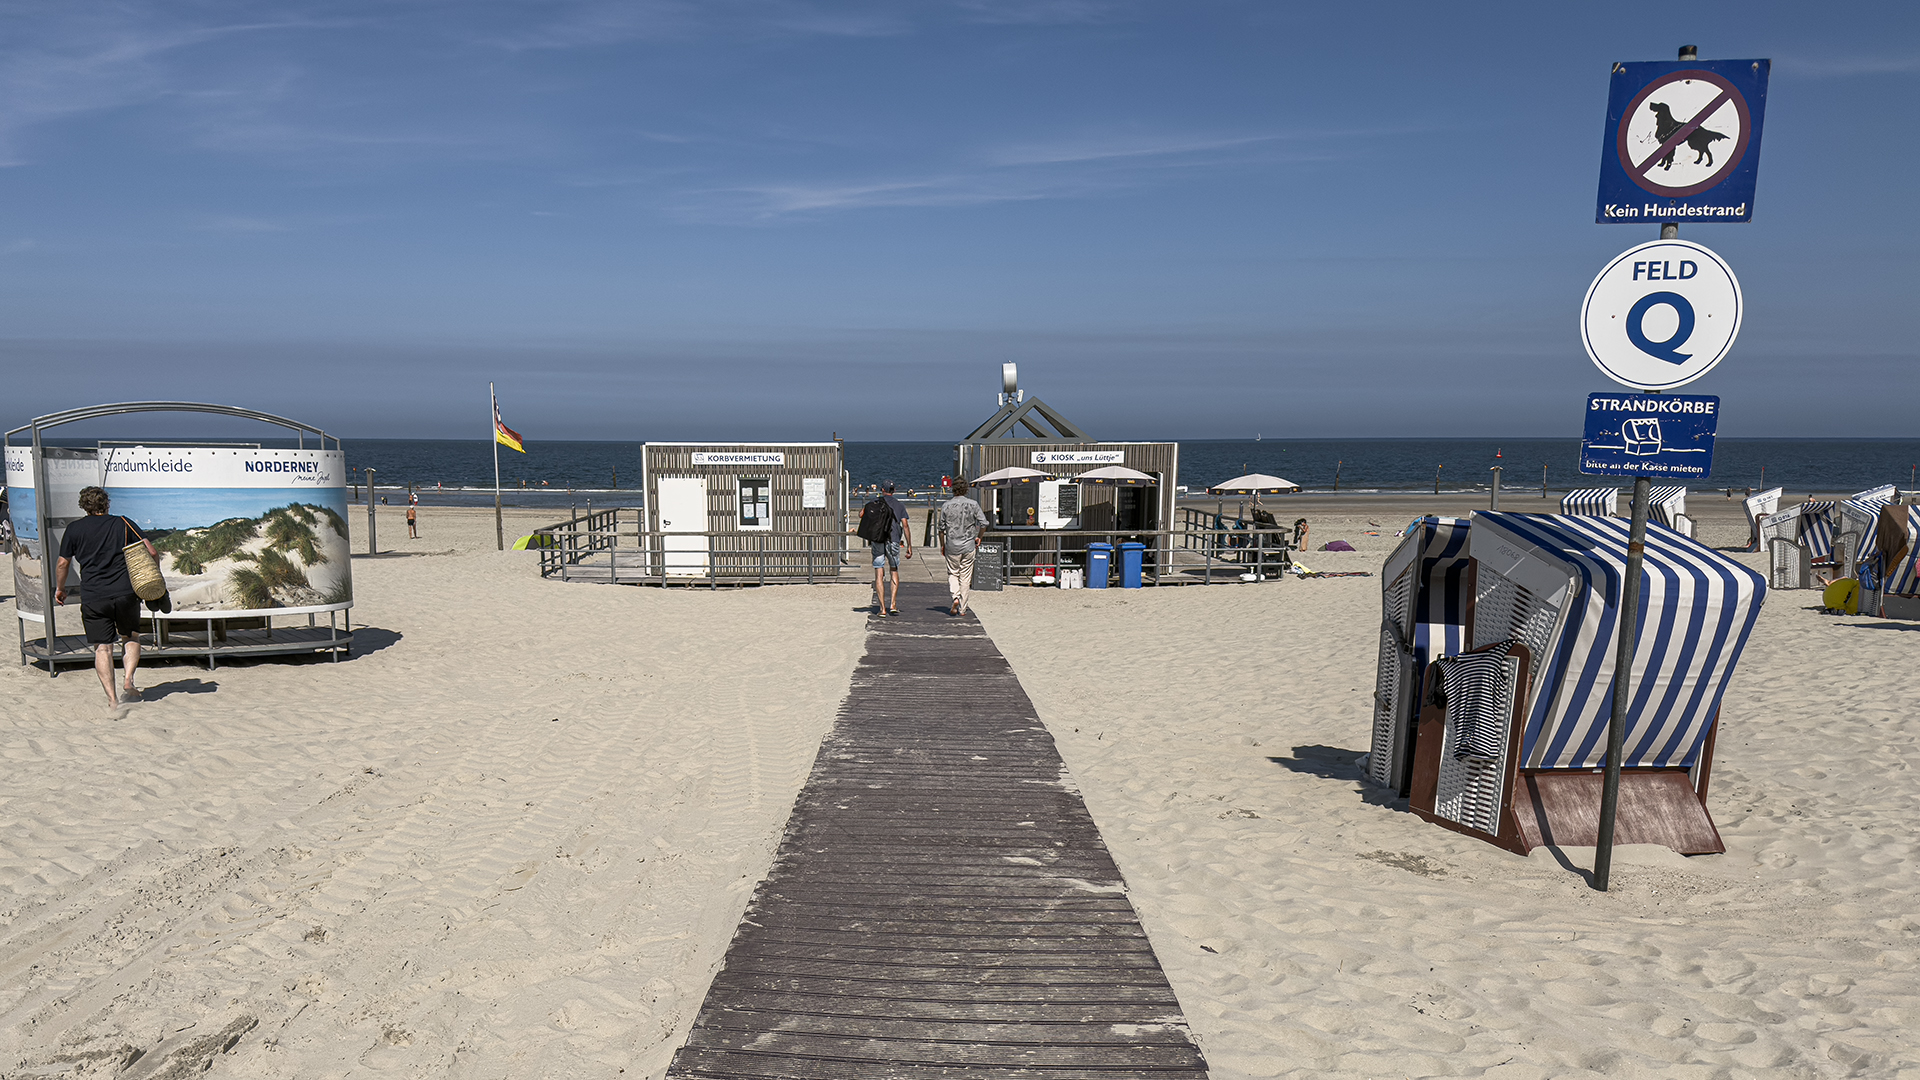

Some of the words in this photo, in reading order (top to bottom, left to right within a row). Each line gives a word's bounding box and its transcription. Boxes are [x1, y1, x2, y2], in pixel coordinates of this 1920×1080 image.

[1604, 204, 1638, 217] Kein
[1644, 203, 1745, 217] Hundestrand
[1632, 260, 1698, 281] FELD
[1625, 291, 1696, 366] Q
[1590, 398, 1715, 414] STRANDKÖRBE
[103, 458, 194, 473] Strandumkleide
[707, 454, 781, 463] KORBVERMIETUNG
[245, 460, 319, 473] NORDERNEY
[1585, 460, 1608, 469] bitte
[1623, 462, 1639, 471] der
[1641, 462, 1668, 472] Kasse
[1670, 464, 1704, 474] mieten
